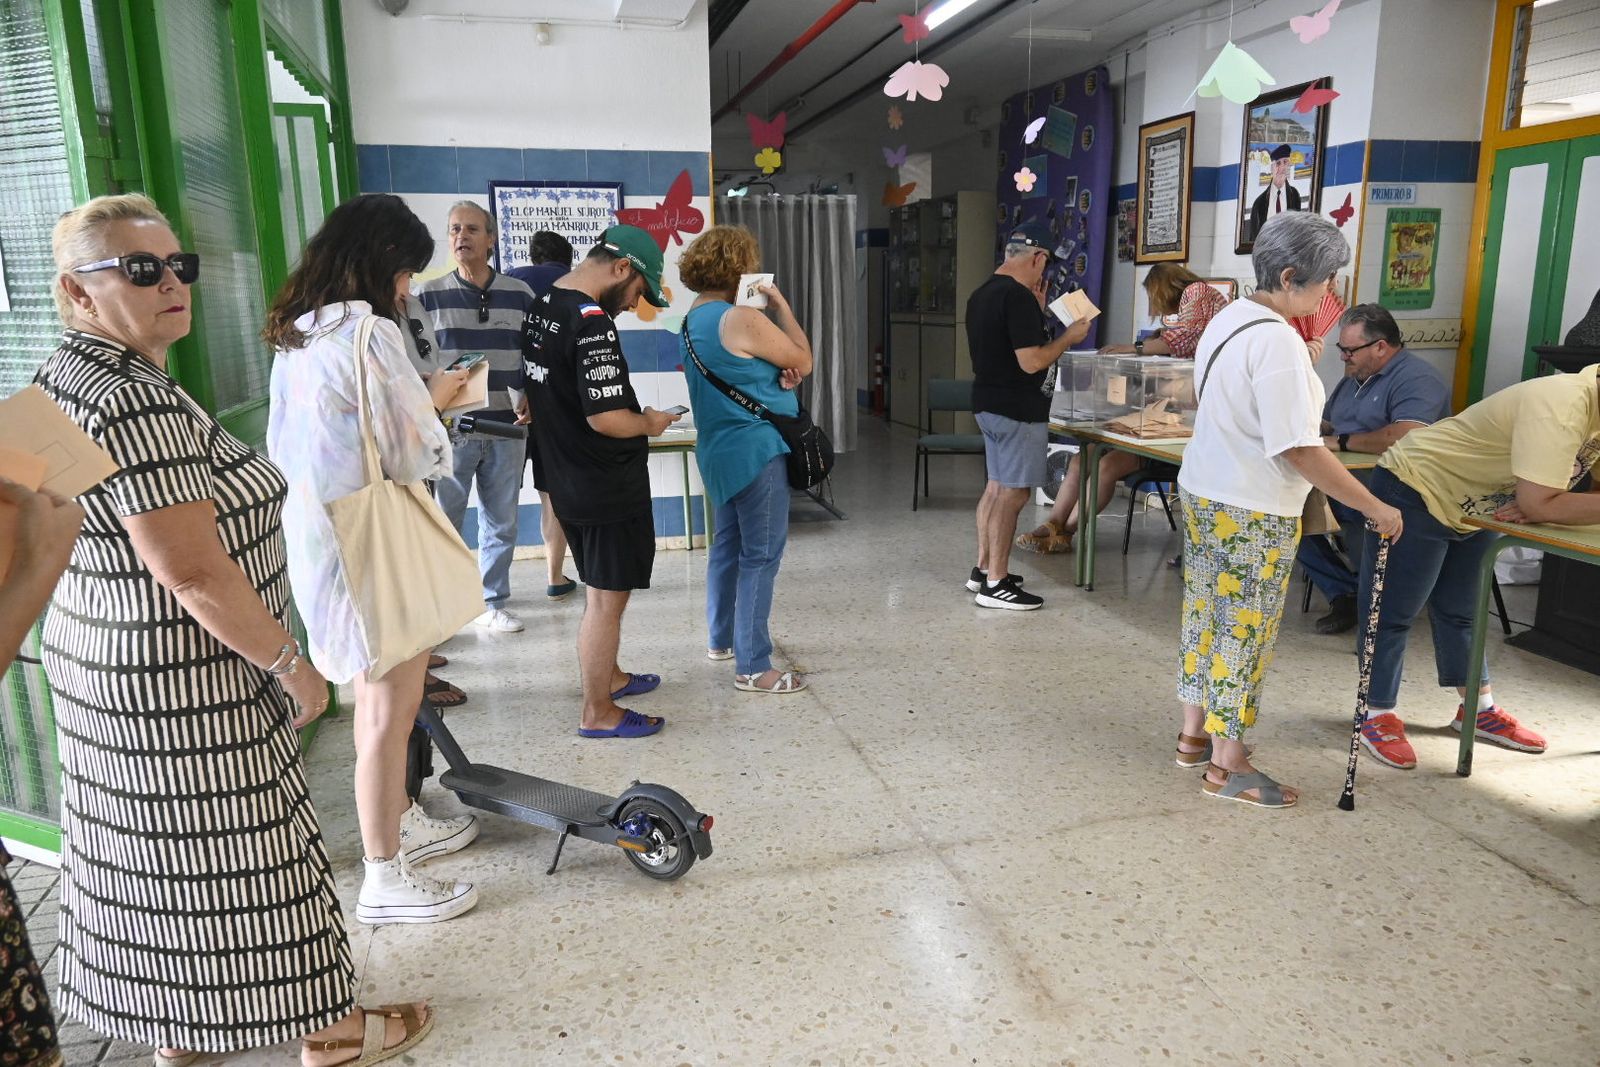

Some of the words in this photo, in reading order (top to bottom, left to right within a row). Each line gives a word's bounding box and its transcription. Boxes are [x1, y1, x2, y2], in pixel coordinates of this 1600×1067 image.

[1371, 188, 1405, 201] PRIMERO
[1406, 187, 1412, 200] B
[536, 206, 573, 217] MANUEL
[552, 222, 599, 232] MANRIQUE
[512, 236, 527, 245] EN
[626, 252, 647, 270] aramco
[589, 364, 617, 381] DUPONT
[601, 384, 623, 398] BWT
